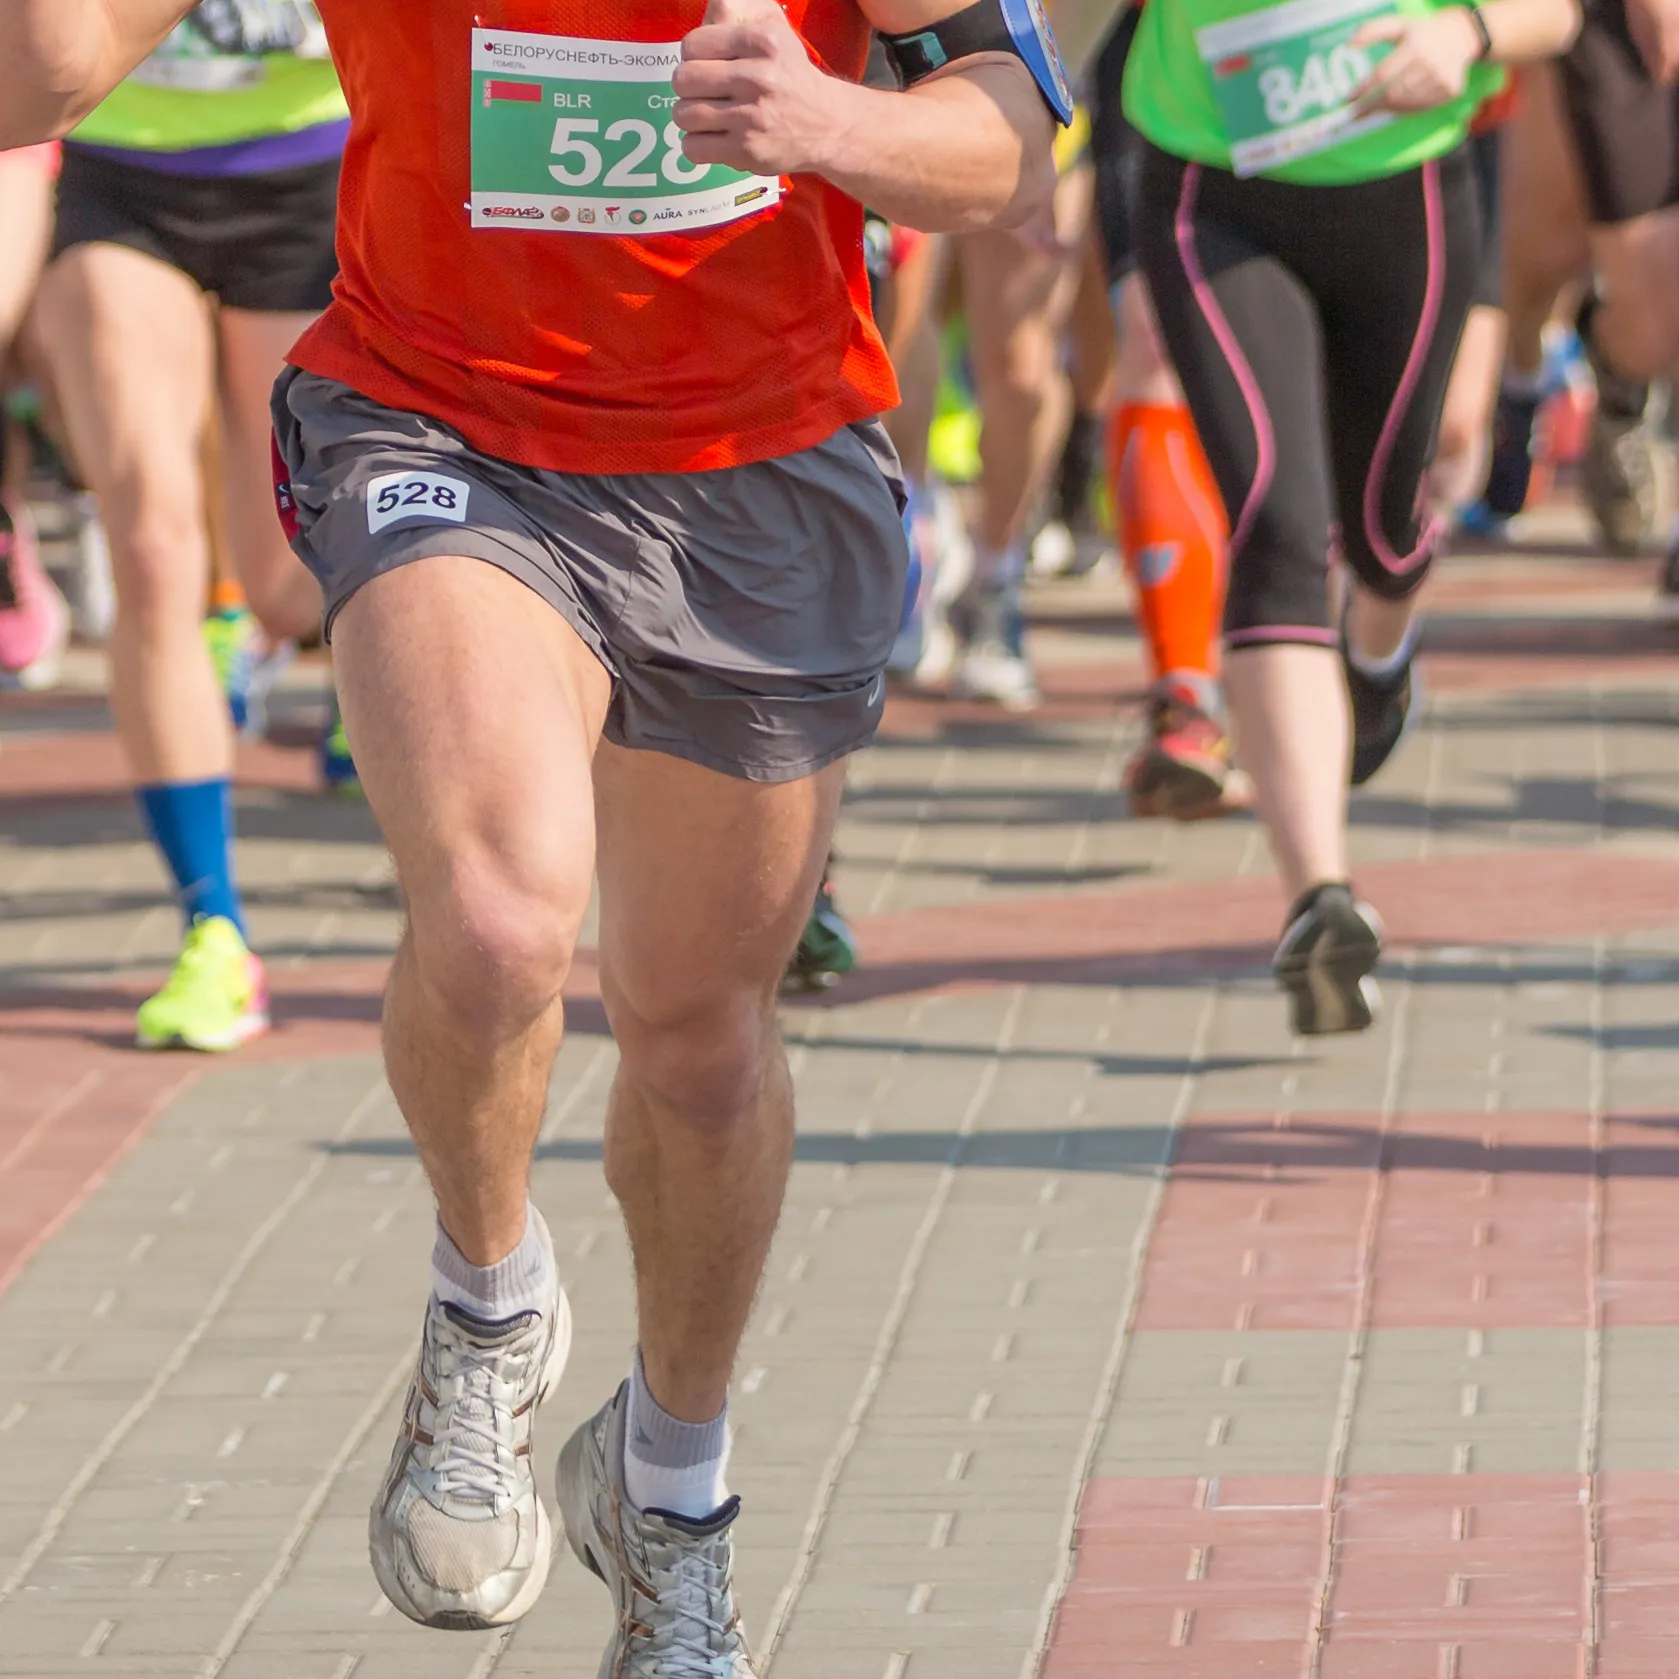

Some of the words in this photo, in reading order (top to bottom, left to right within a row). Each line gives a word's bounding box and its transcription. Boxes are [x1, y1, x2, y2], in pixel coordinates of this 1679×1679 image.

[493, 43, 684, 66] БЕЛОРУСНЕФТЬ-ЭКОМА
[553, 92, 592, 109] BLR
[548, 117, 711, 187] 528
[653, 210, 683, 220] AURA
[376, 481, 457, 513] 528
